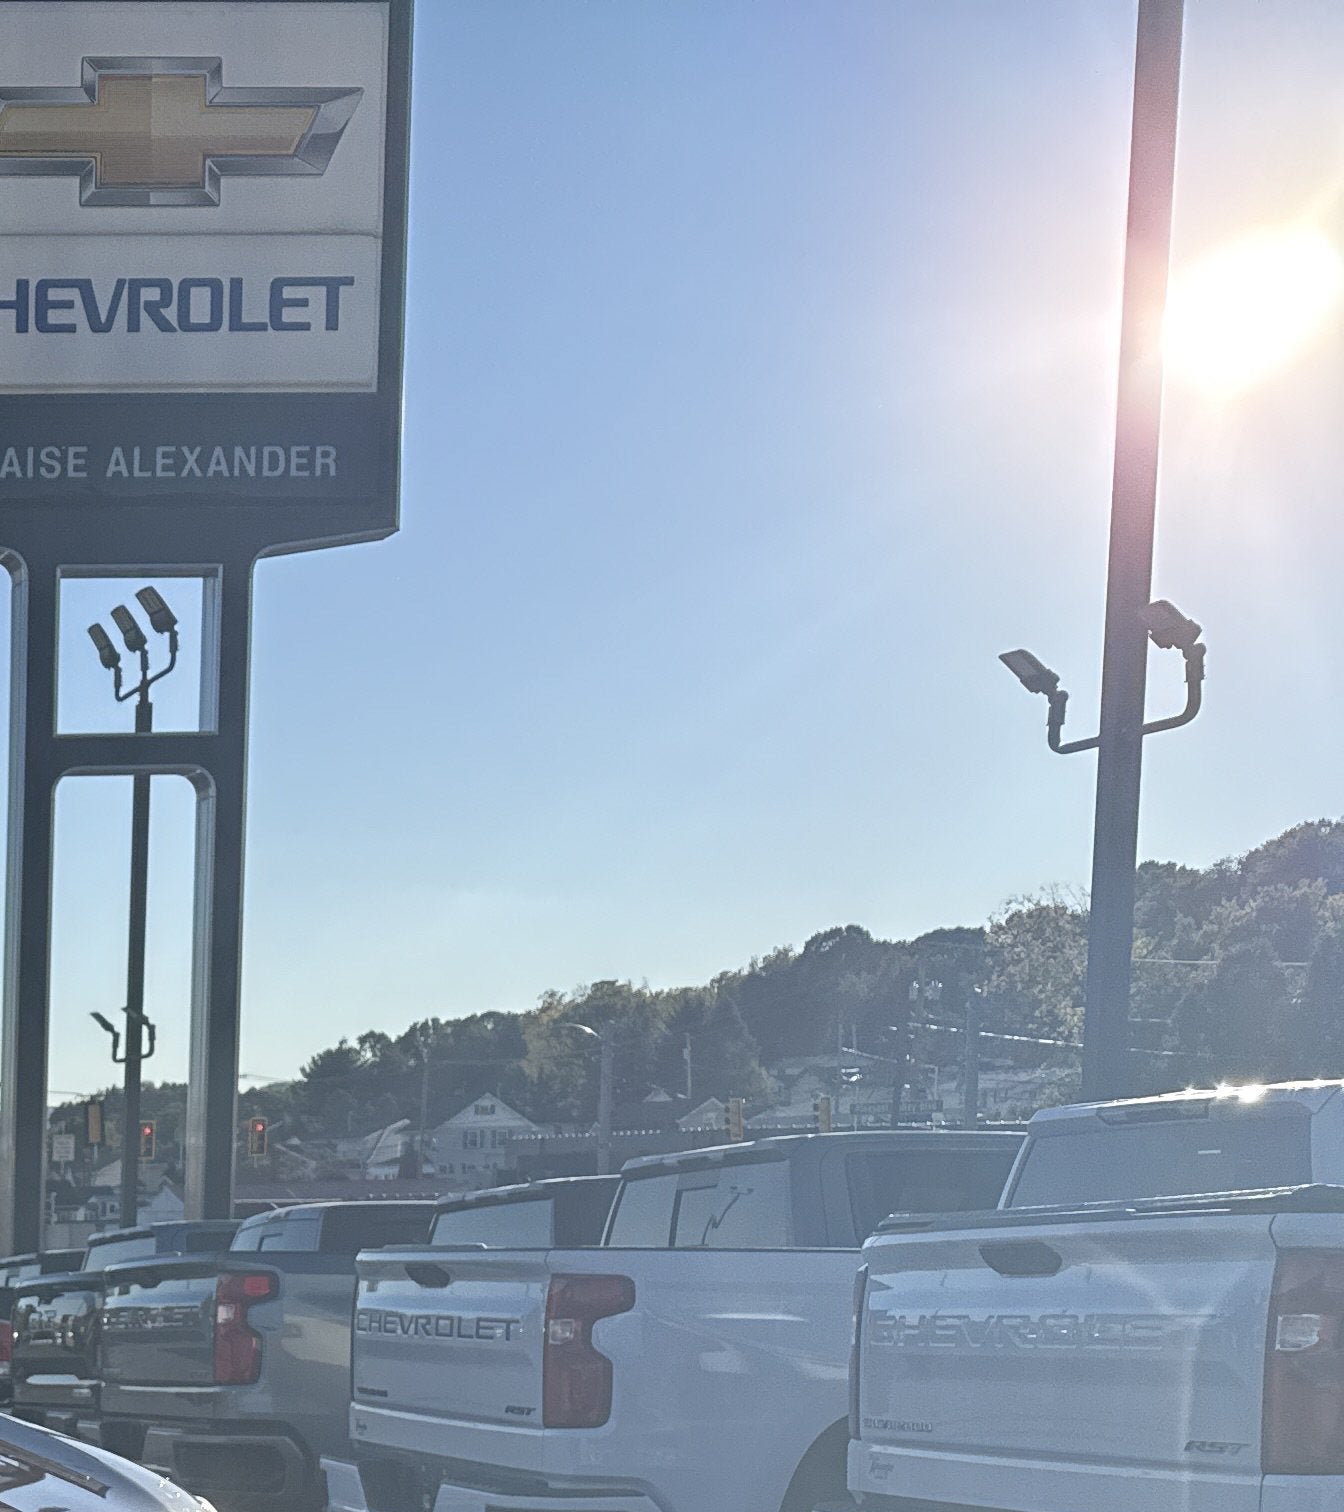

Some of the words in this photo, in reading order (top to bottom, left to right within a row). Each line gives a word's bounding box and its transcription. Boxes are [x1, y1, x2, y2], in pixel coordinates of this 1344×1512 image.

[105, 444, 337, 479] ALEXANDER
[356, 1310, 521, 1342] CHEVROLET
[1183, 1440, 1252, 1456] RST
